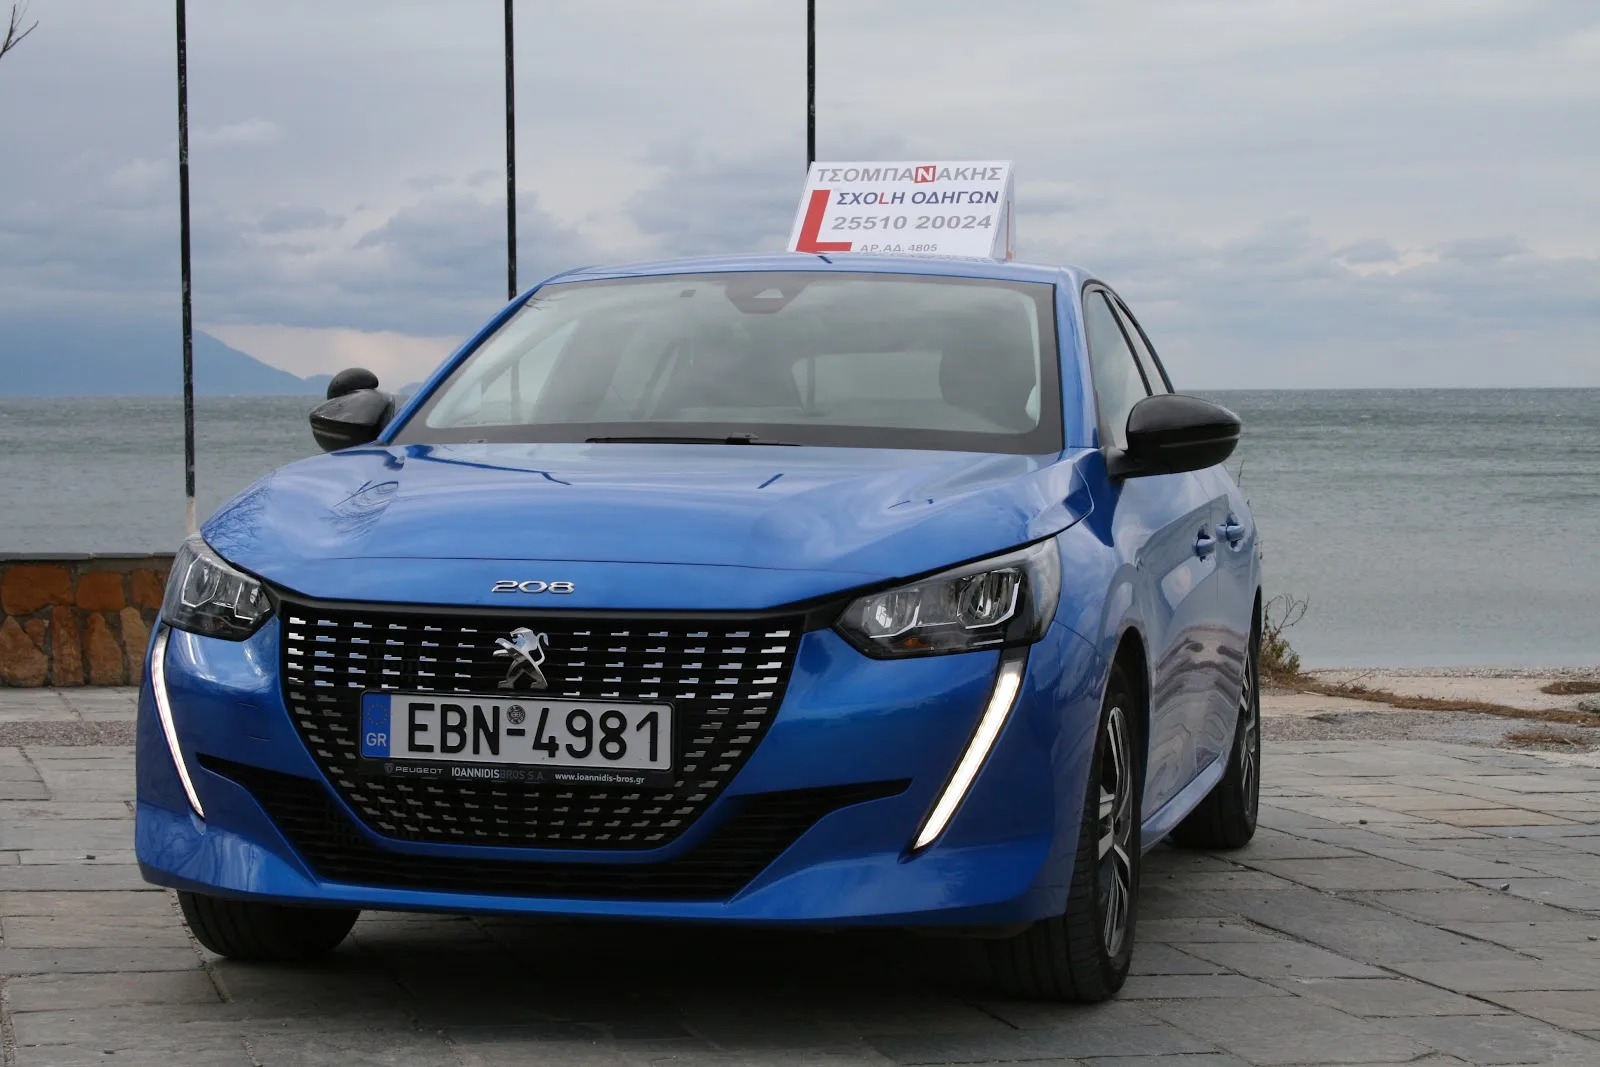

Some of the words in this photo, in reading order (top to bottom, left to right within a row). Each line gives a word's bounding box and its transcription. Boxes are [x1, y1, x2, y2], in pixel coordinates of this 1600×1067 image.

[817, 165, 1003, 183] ΤΣΟΜΠΑΝΑΚΗΣ
[911, 191, 999, 204] ΟΔΗΓΩΝ
[795, 189, 853, 253] L
[831, 216, 907, 230] 25510
[915, 215, 992, 229] 20024
[908, 243, 938, 252] 4805
[491, 580, 575, 594] 208
[408, 701, 659, 763] EBN-4981
[366, 732, 387, 747] GR
[395, 766, 444, 775] PEUGEOT
[554, 772, 645, 785] www.ioannidis-bros.gr
